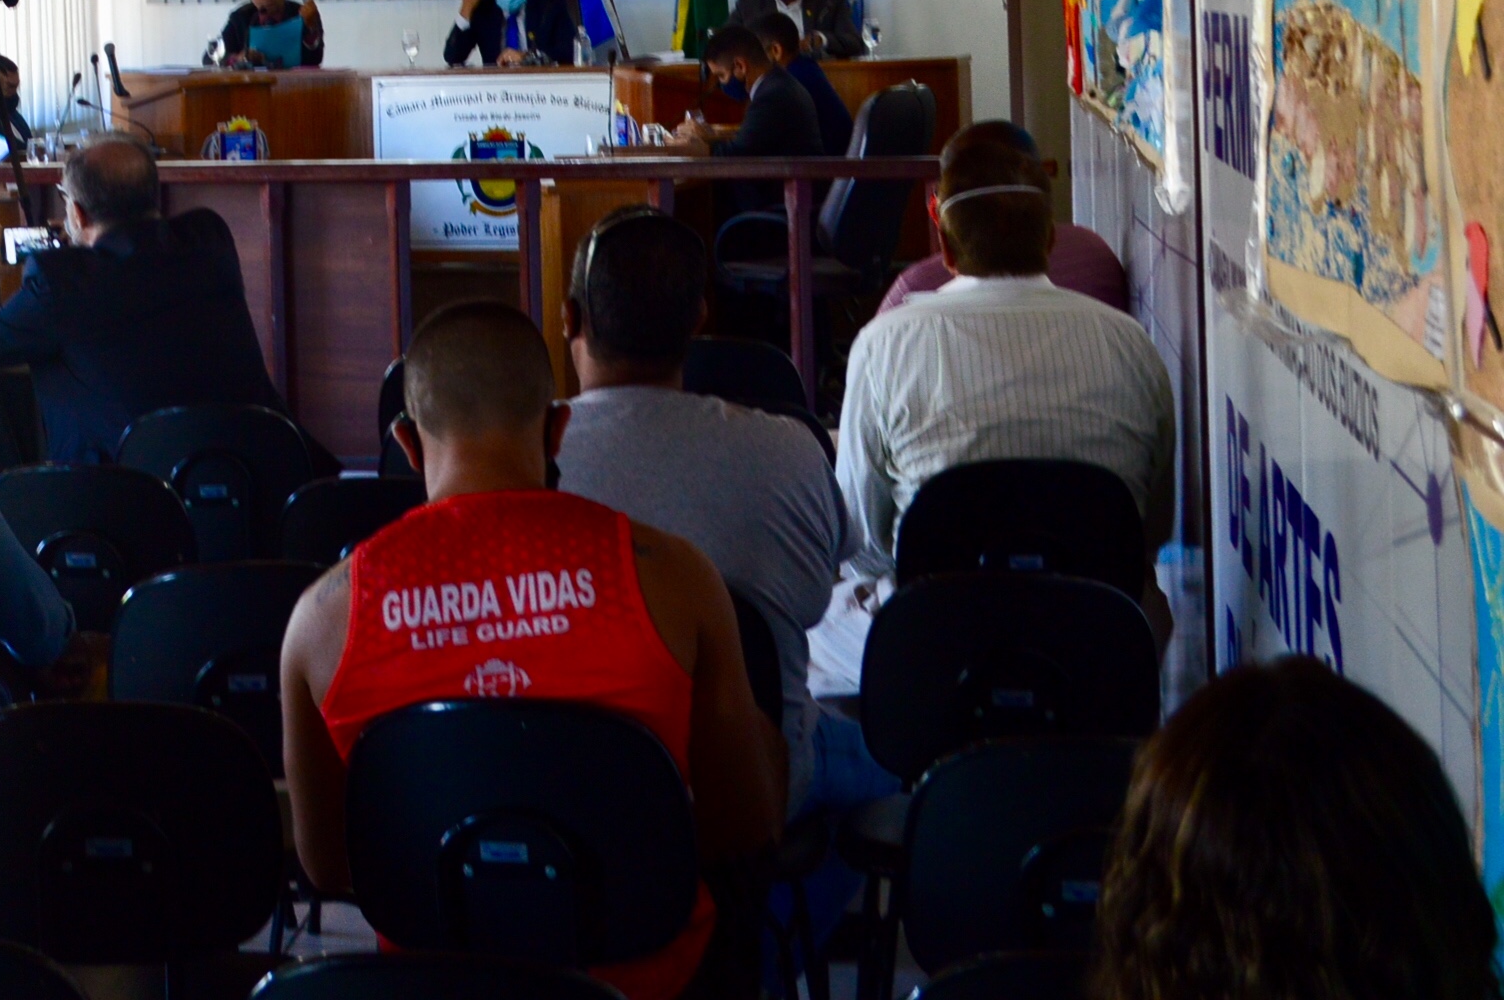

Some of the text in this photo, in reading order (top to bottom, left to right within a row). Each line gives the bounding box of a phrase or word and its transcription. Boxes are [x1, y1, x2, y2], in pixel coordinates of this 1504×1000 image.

[386, 100, 427, 118] Câmara
[431, 90, 483, 110] Municipal
[486, 91, 498, 104] de
[501, 90, 546, 106] Armação
[442, 222, 477, 239] Poder
[1226, 392, 1254, 581] DE
[1259, 440, 1344, 675] ARTES
[382, 568, 596, 632] GUARDA VIDAS
[411, 614, 570, 651] LIFE GUARD
